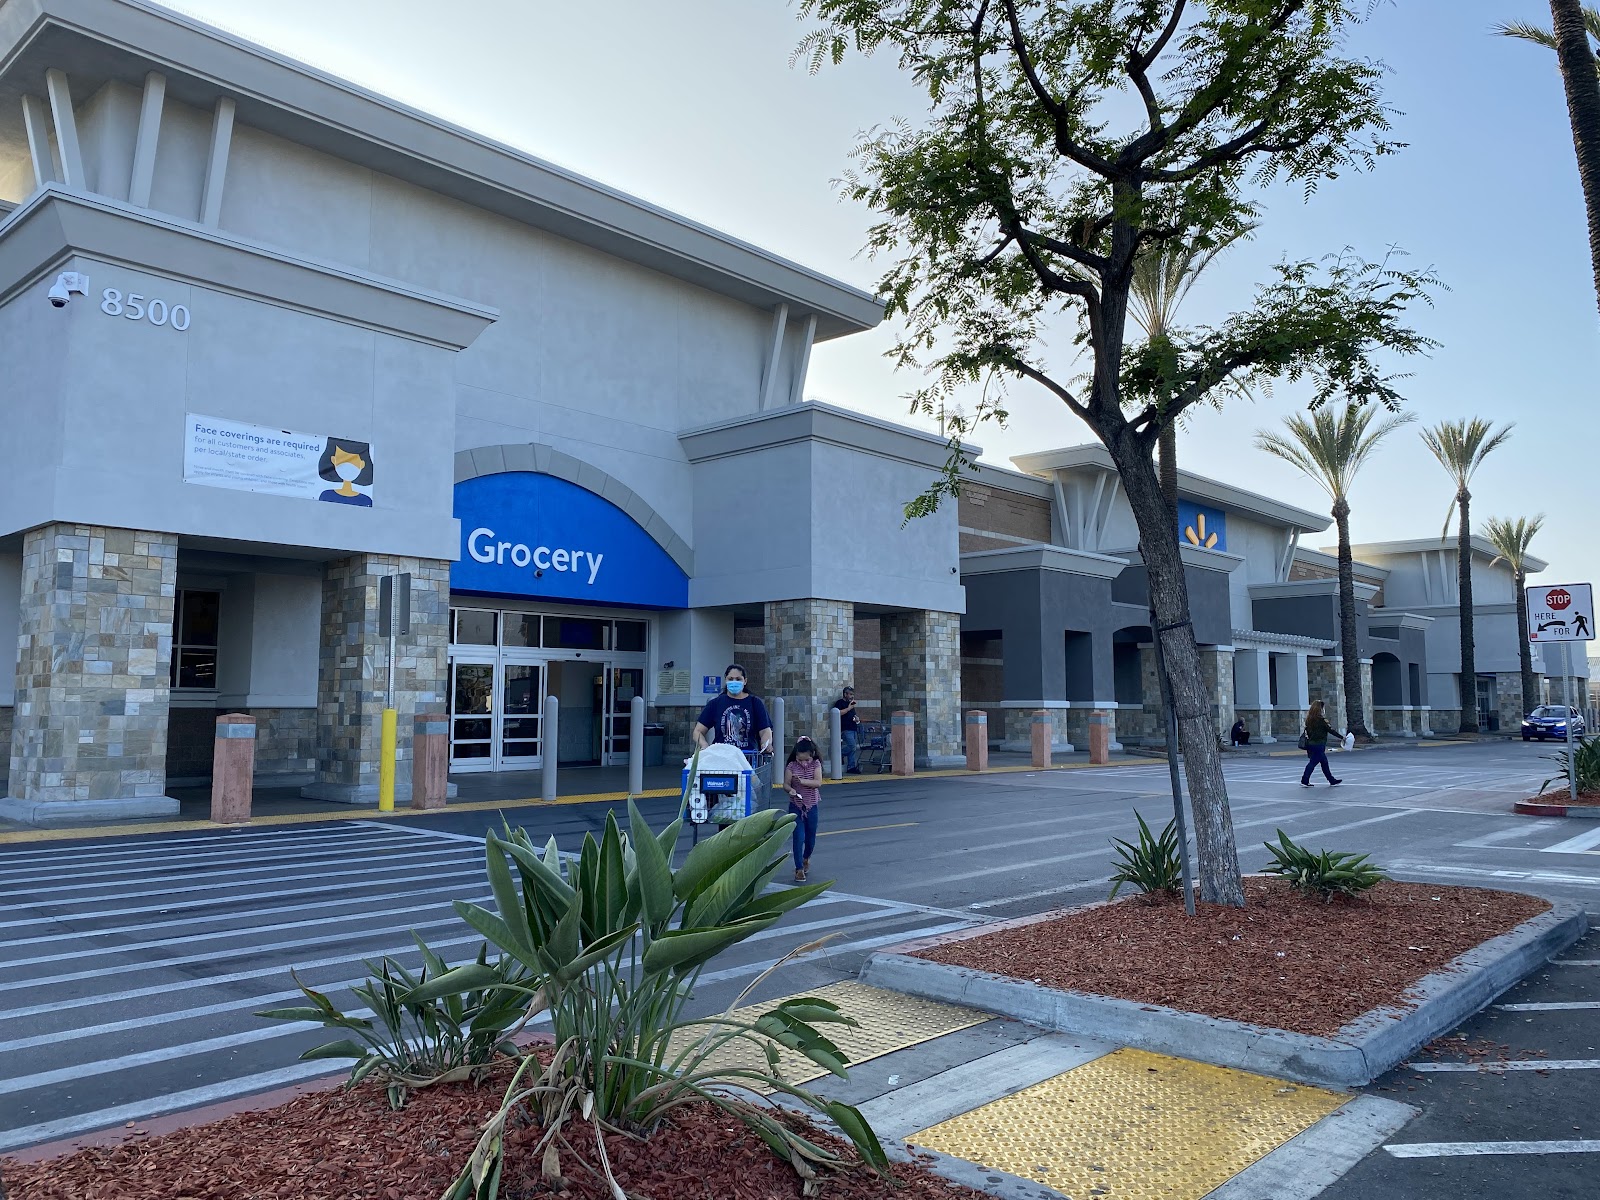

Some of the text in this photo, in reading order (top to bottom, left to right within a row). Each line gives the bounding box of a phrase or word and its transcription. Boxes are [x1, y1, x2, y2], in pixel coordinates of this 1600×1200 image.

[101, 287, 191, 331] 8500
[195, 423, 320, 452] Face coverings are required
[207, 437, 216, 445] all
[217, 440, 254, 452] customers
[256, 445, 269, 453] and
[194, 446, 268, 463] per local/state order.
[467, 527, 604, 585] Grocery
[1546, 594, 1570, 605] STOP
[1534, 612, 1557, 621] HERE
[1553, 627, 1571, 636] FOR
